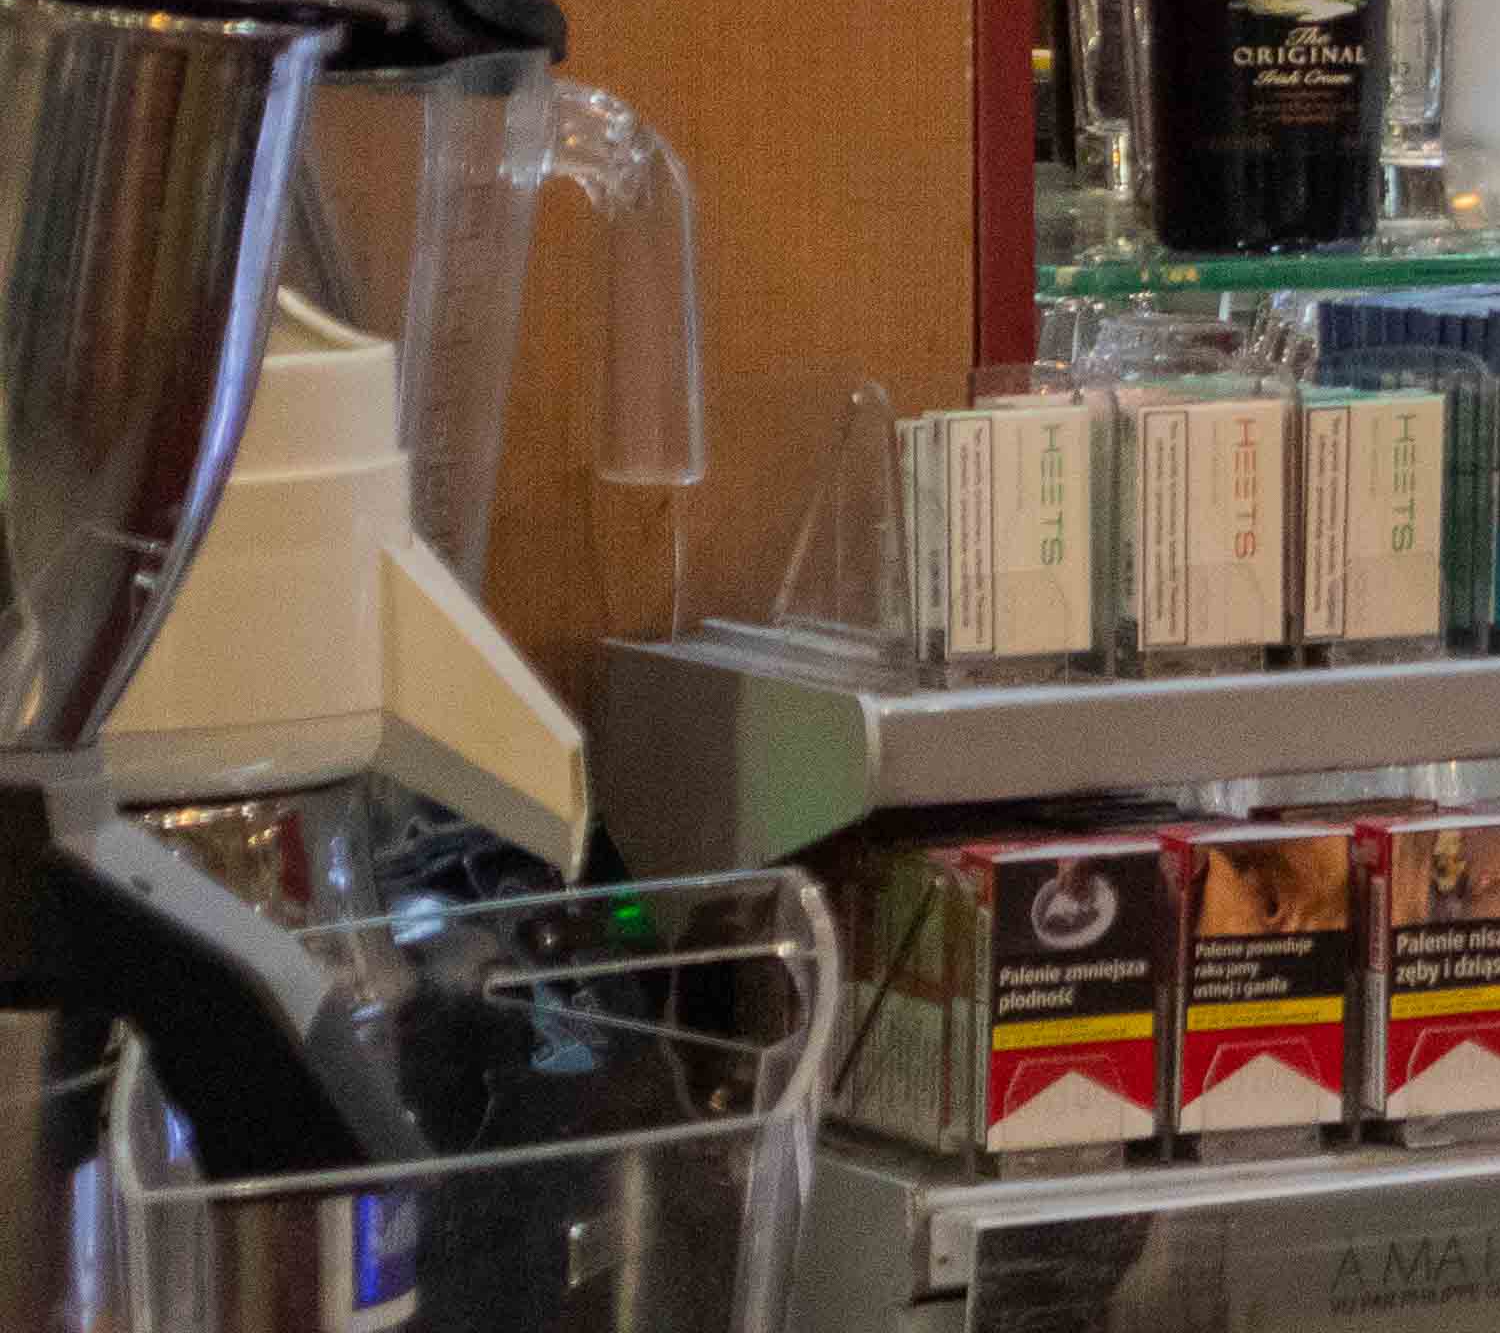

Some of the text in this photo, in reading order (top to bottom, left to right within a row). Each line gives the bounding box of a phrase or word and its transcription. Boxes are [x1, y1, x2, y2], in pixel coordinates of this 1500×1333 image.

[1284, 26, 1330, 47] The
[1233, 46, 1366, 66] ORIGINAL
[1040, 423, 1065, 567] HEETS
[1233, 417, 1258, 560] HEETS
[1392, 412, 1417, 554] HEETS
[1194, 940, 1240, 960] Palenie
[1395, 932, 1465, 957] Palenie
[998, 959, 1147, 989] Palenie zmniejsza
[1395, 959, 1439, 985] zęby
[1442, 957, 1451, 979] i
